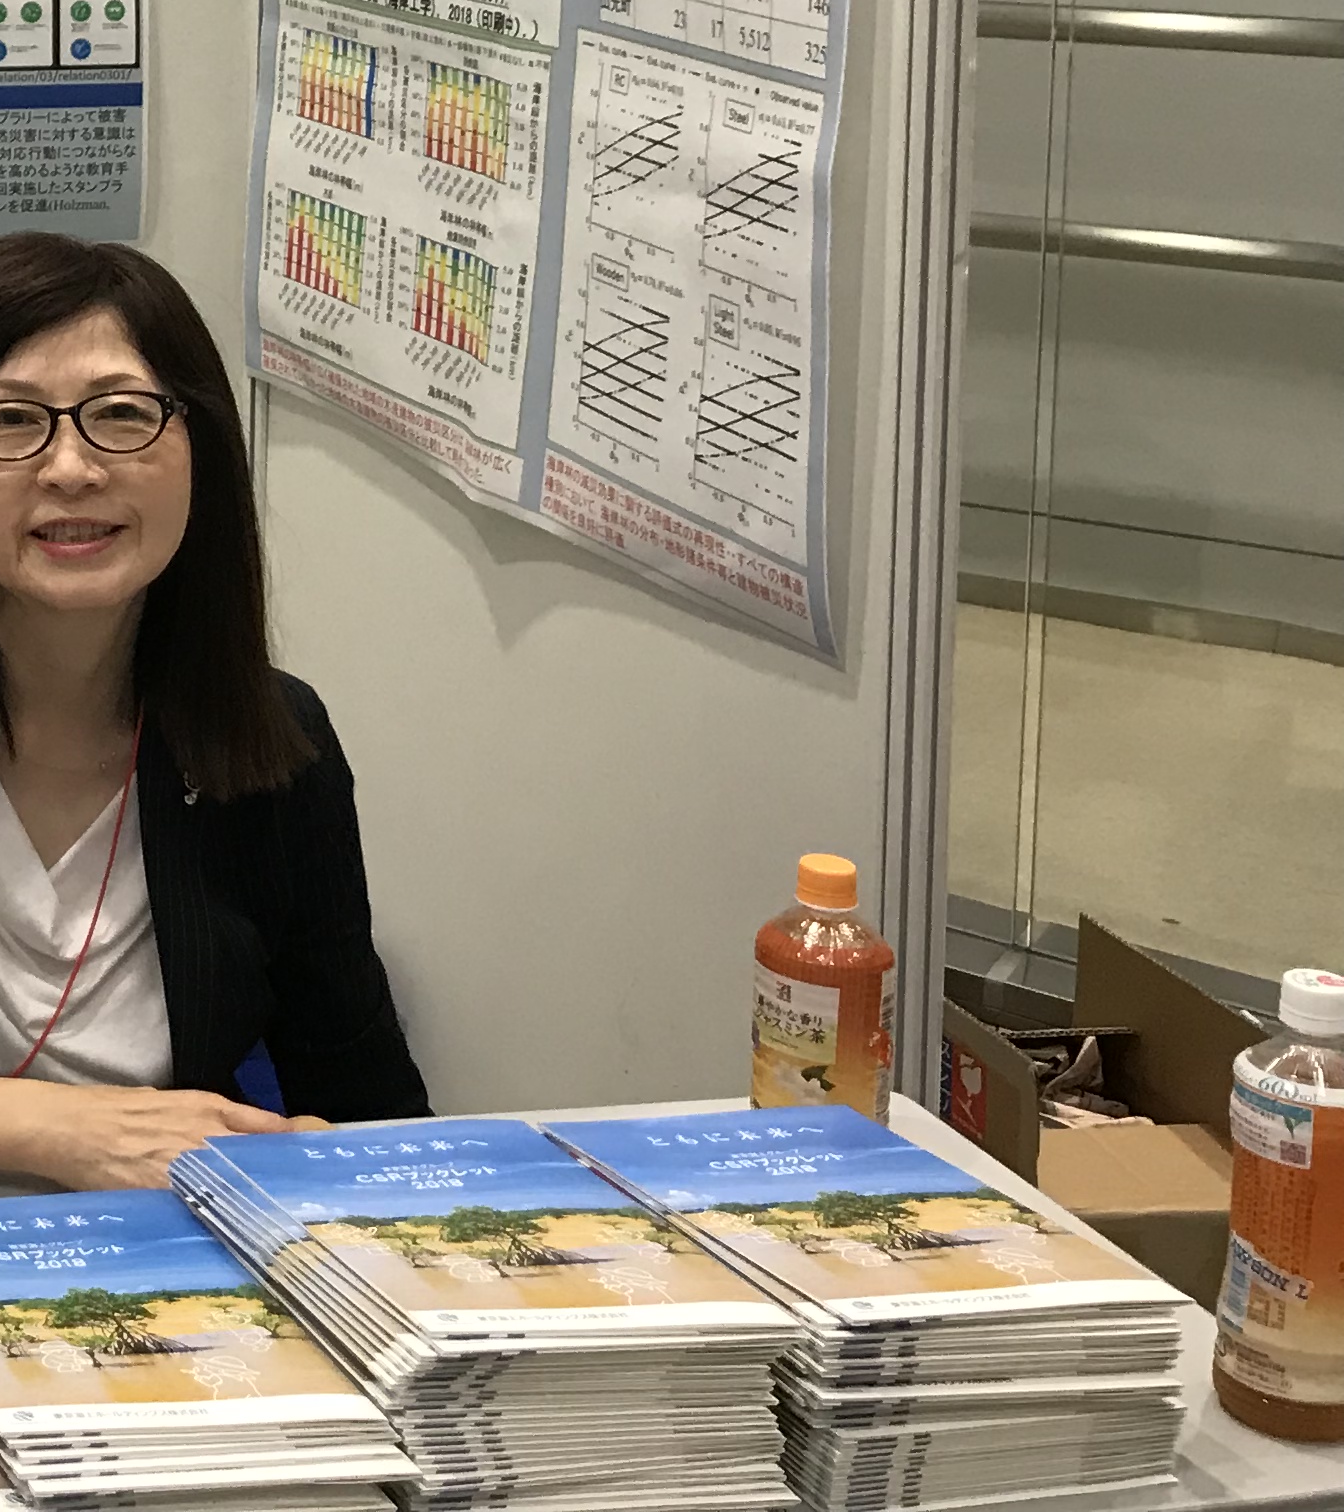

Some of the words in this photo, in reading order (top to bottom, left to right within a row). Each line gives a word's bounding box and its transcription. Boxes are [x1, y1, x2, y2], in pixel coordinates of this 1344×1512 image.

[647, 1125, 824, 1148] ともに未来へ
[304, 1138, 489, 1161] ともに未来へ
[710, 1150, 845, 1173] CSRブックレット
[766, 1162, 817, 1178] 2018
[355, 1164, 498, 1186] CSRブックレット
[411, 1177, 464, 1191] 2018
[33, 1257, 87, 1271] 2018
